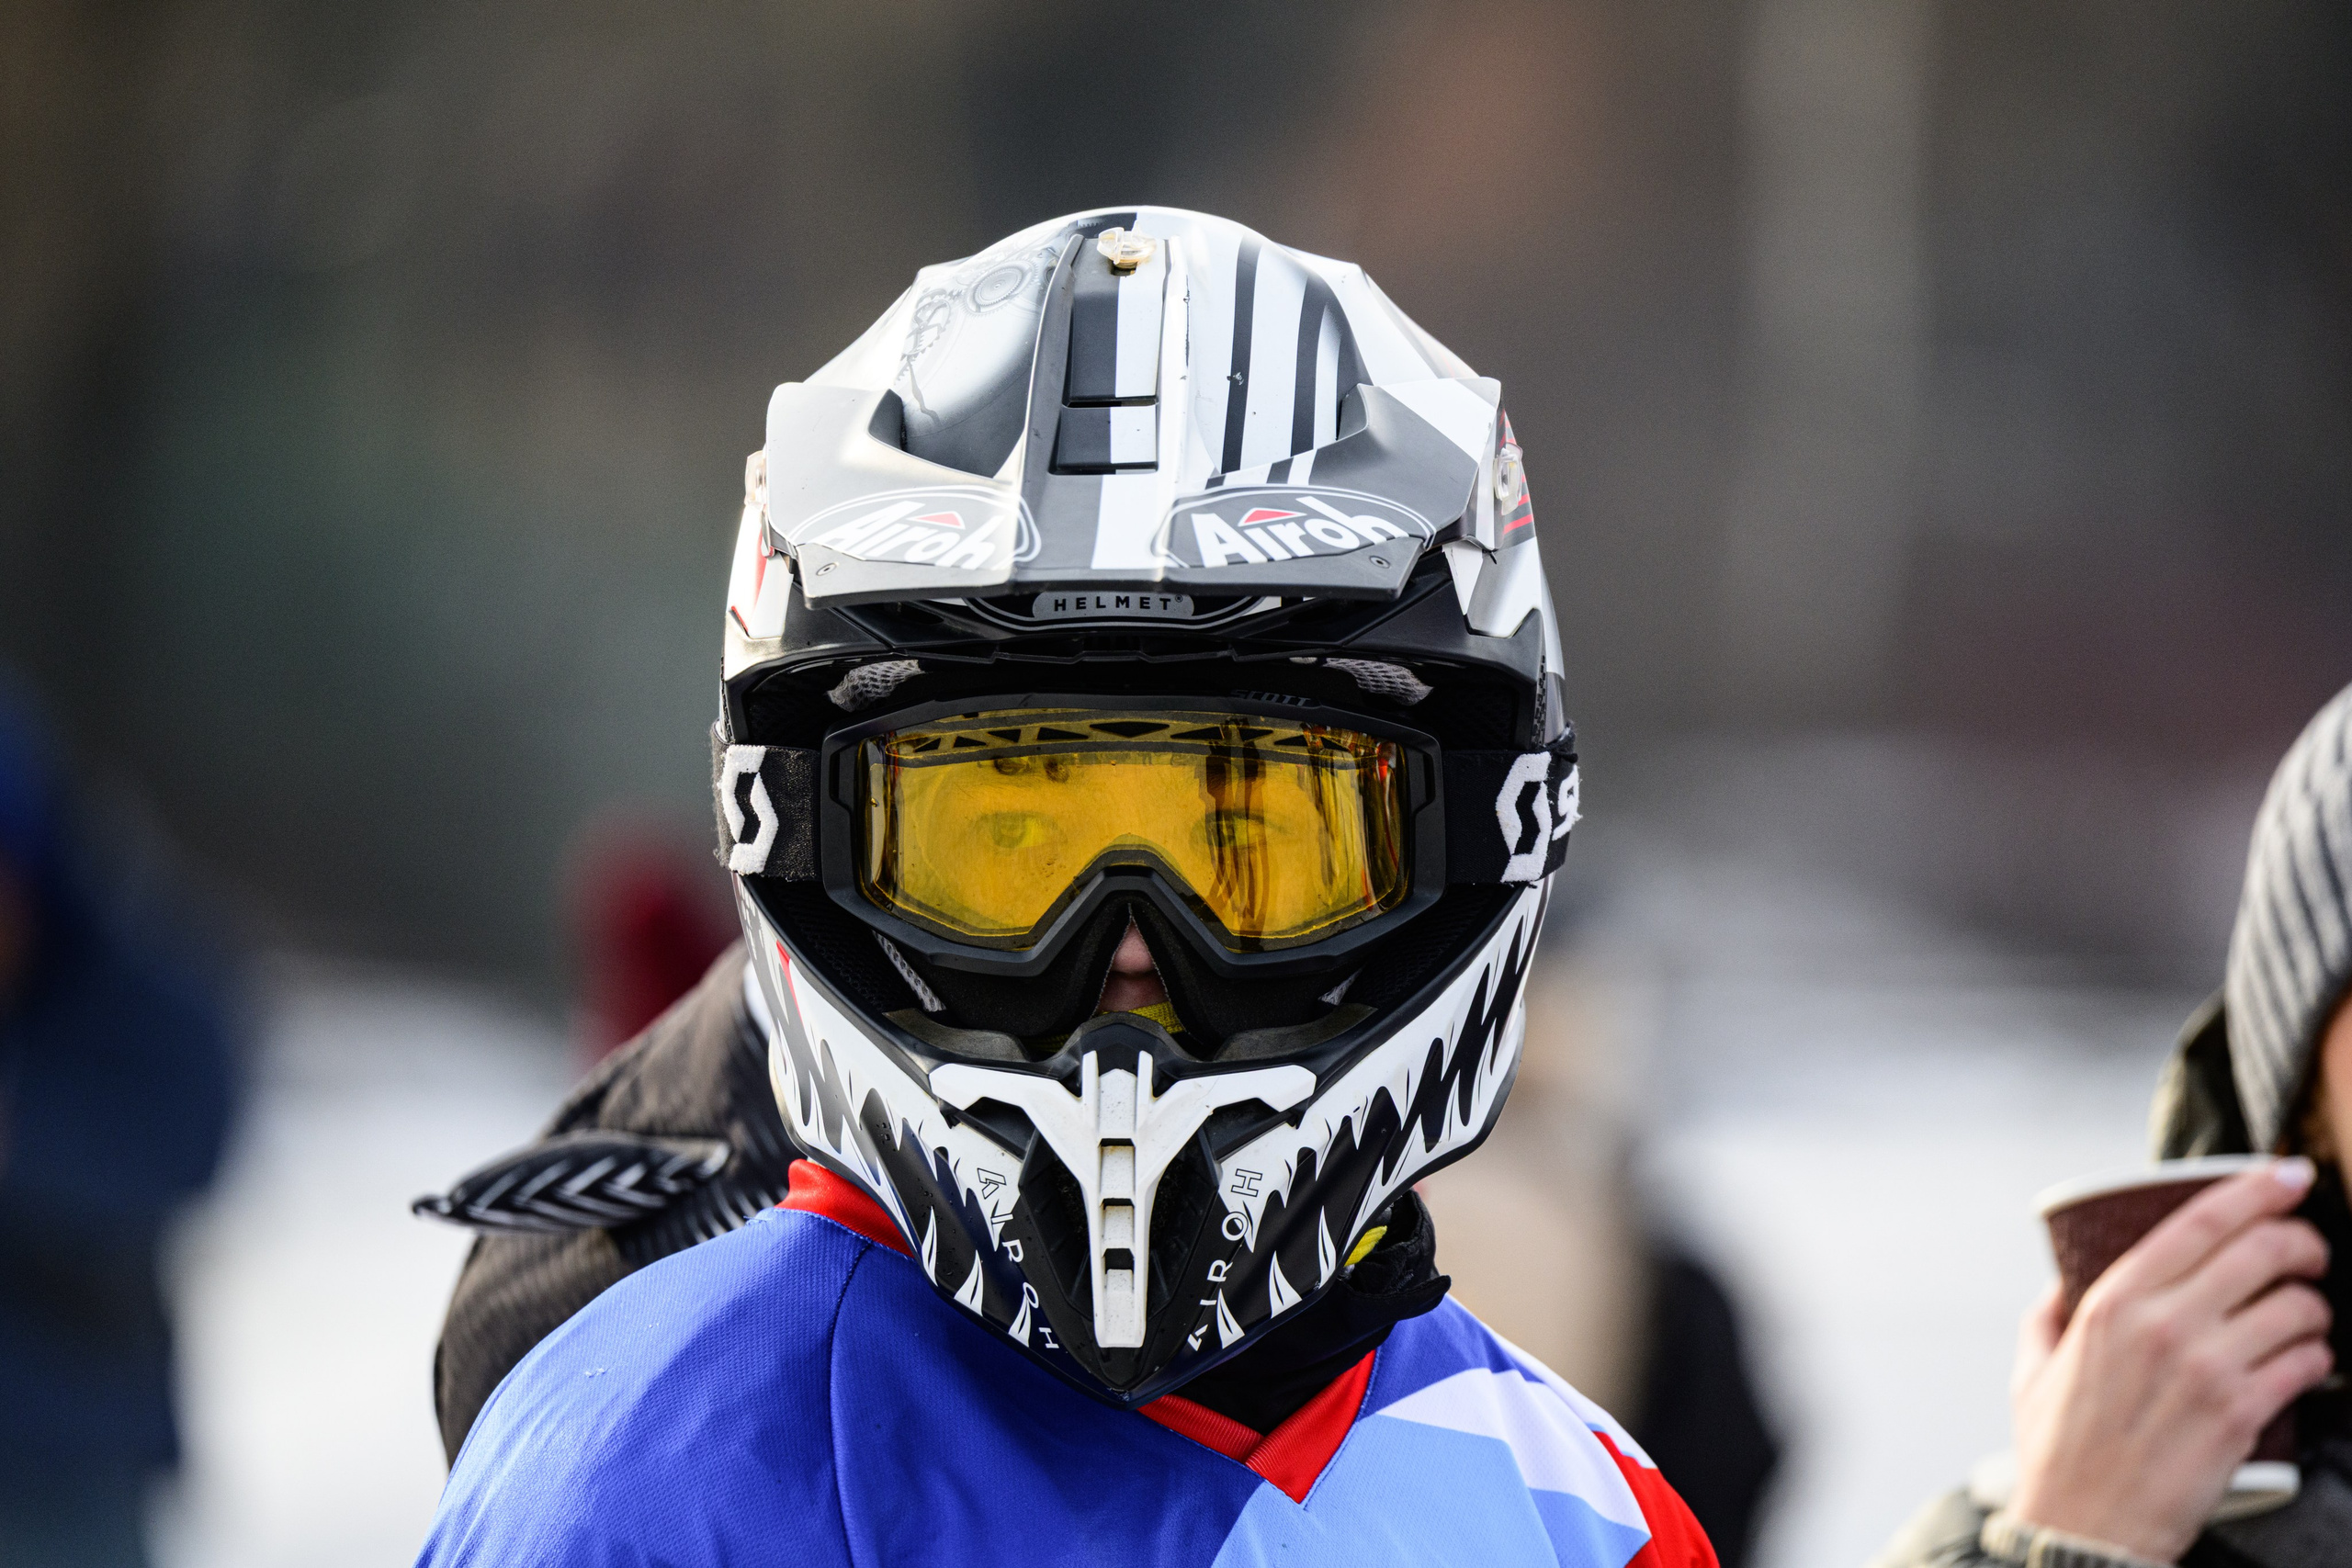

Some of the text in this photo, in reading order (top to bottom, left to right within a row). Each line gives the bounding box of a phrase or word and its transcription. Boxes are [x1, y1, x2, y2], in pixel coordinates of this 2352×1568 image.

[808, 500, 1007, 570] Airoh
[1191, 496, 1410, 568] Airoh
[1230, 689, 1312, 707] SCOTT
[977, 1168, 1060, 1349] AIROH
[1186, 1168, 1264, 1352] AIROH
